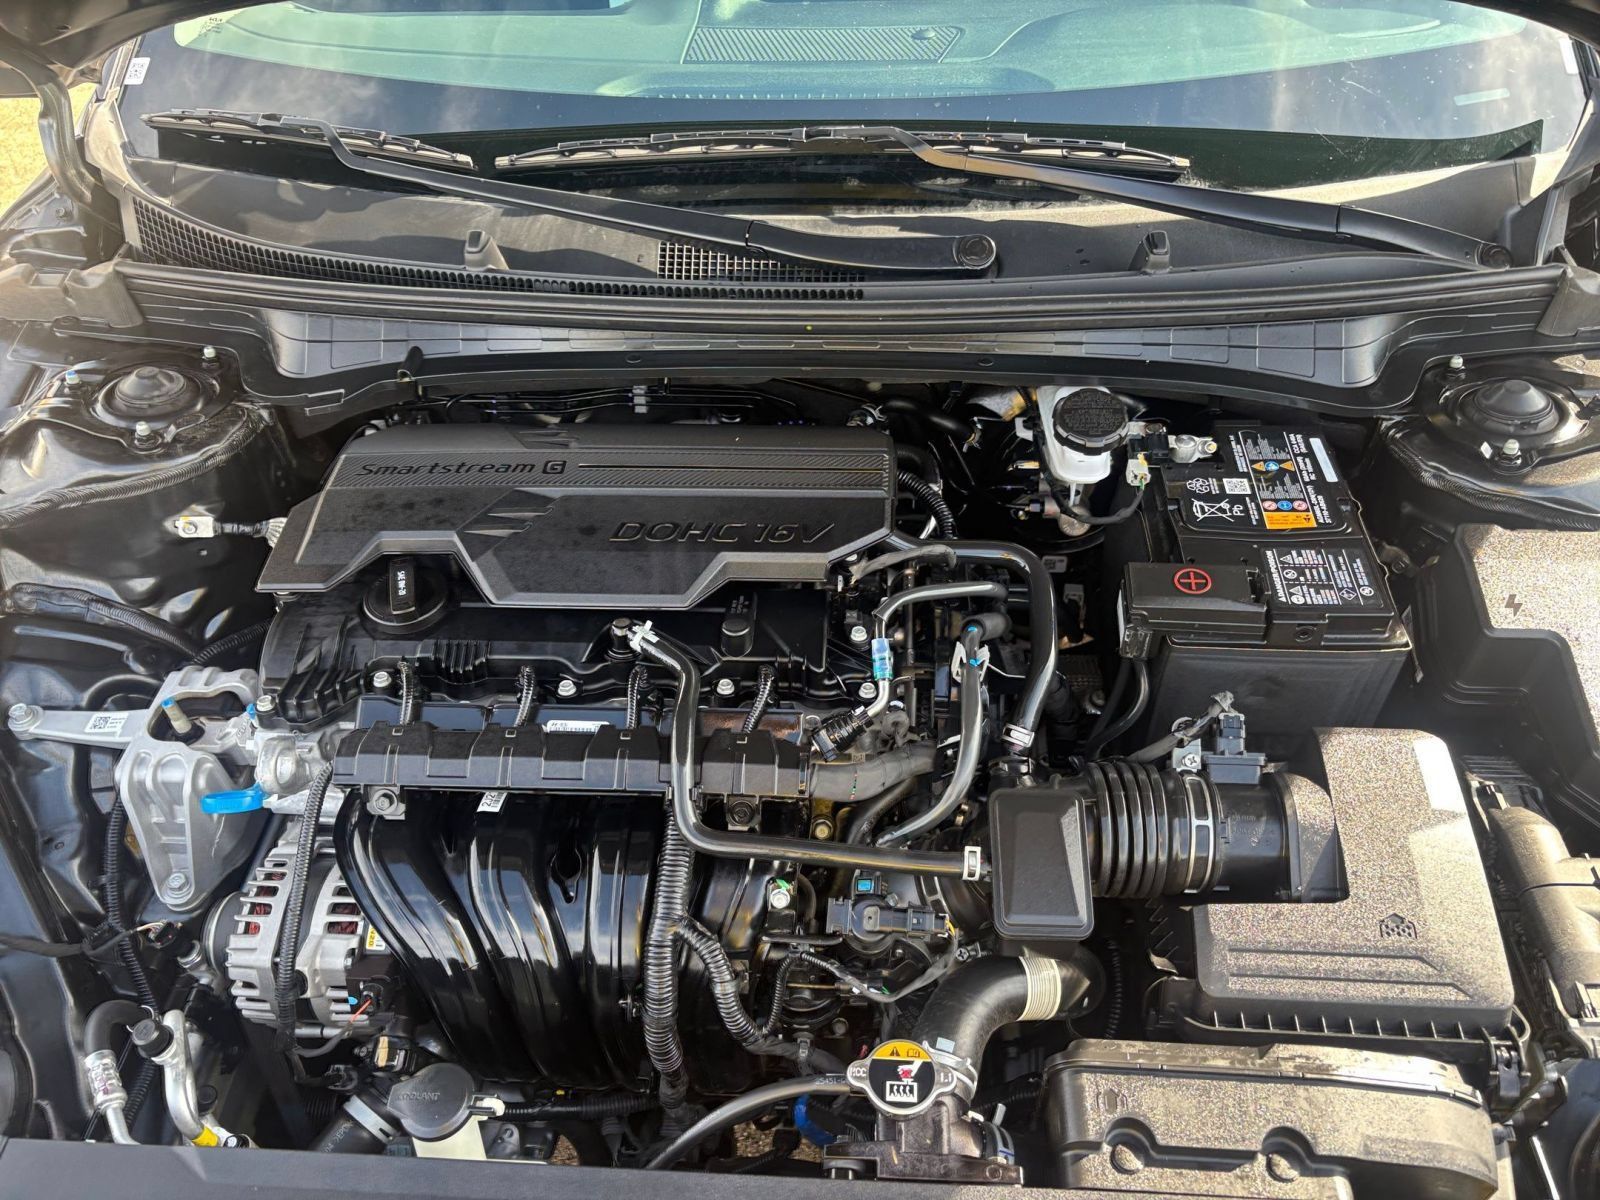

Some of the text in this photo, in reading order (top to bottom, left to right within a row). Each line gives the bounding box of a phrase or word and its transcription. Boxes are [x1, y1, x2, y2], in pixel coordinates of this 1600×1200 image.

[357, 459, 537, 477] Smartstream
[1232, 504, 1245, 516] Pb
[609, 522, 836, 543] DOHC 16V
